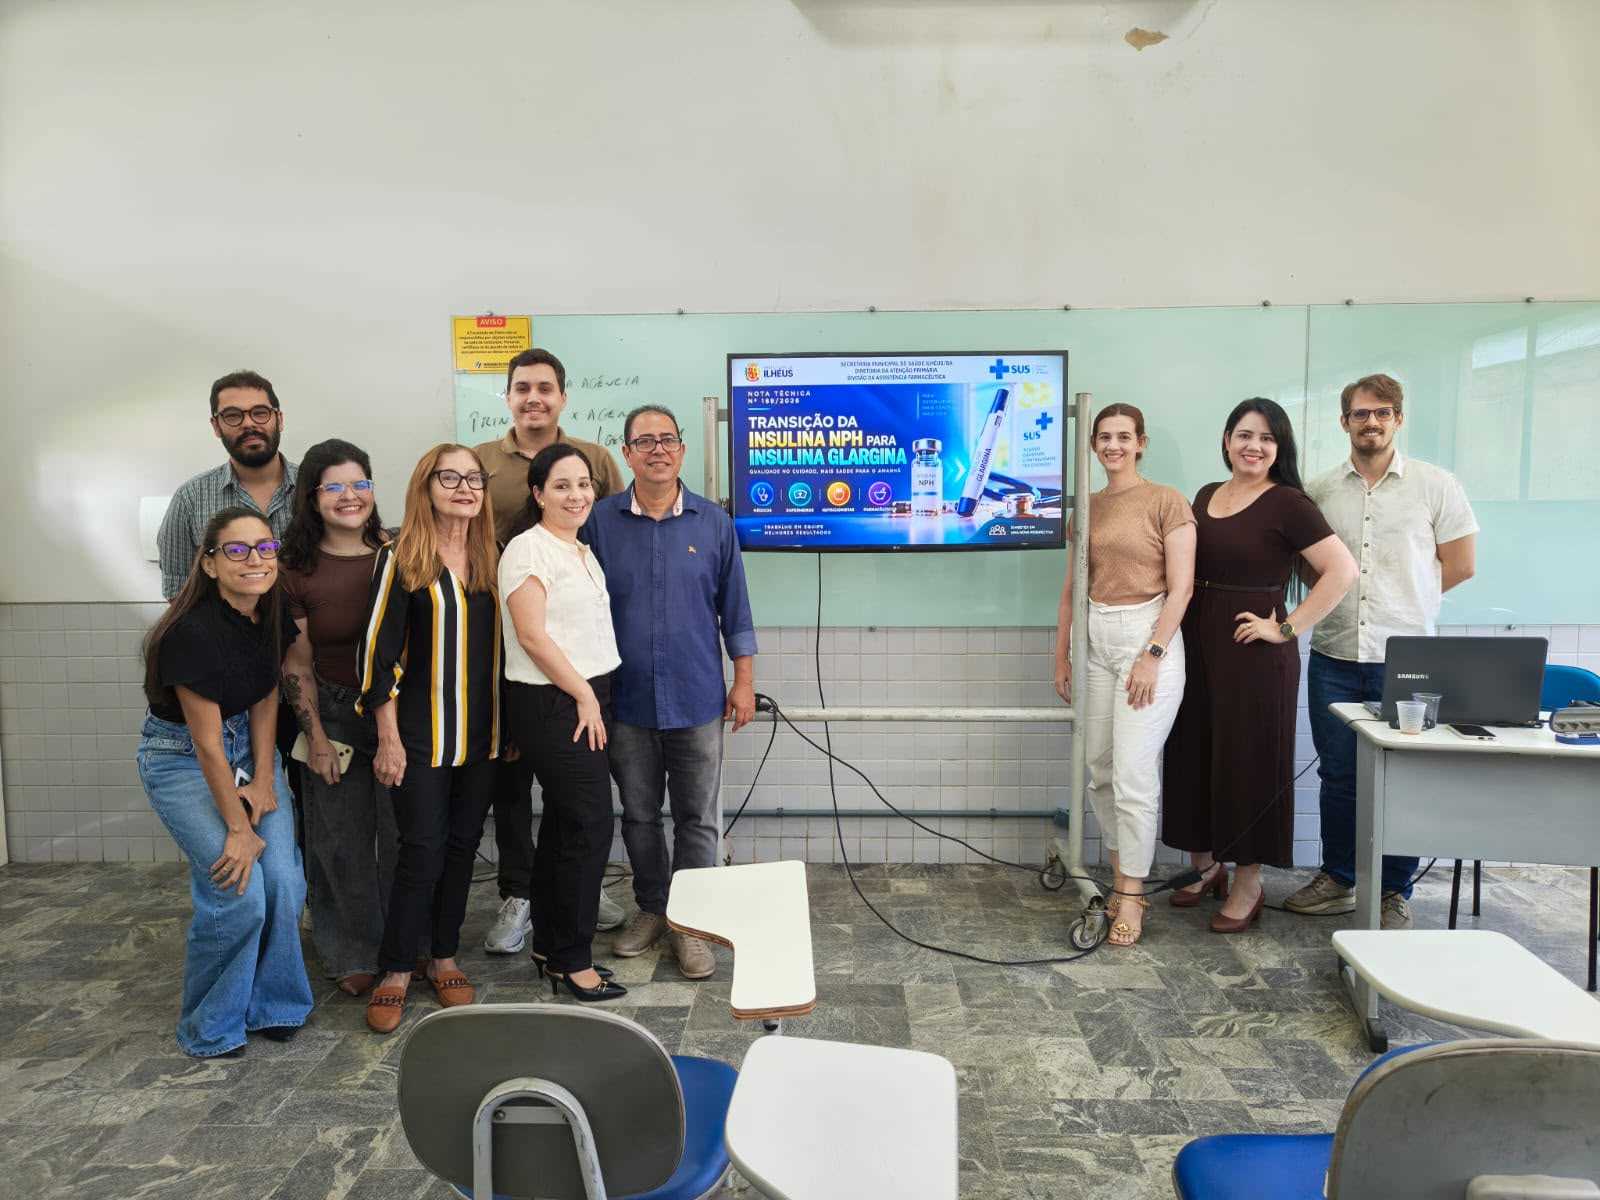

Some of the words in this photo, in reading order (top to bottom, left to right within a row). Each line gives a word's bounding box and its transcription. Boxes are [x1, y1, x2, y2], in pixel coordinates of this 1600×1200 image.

[763, 367, 794, 378] ILHÉUS
[1010, 364, 1031, 374] SUS
[587, 409, 626, 421] AGEN
[748, 413, 835, 431] TRANSIÇÃO
[837, 416, 858, 428] DA
[748, 431, 826, 448] INSULINA
[829, 430, 863, 447] NPH
[866, 435, 897, 446] PARA
[1023, 431, 1041, 441] SUS
[749, 448, 825, 466] INSULINA
[828, 447, 908, 465] GLARGINA
[976, 447, 992, 482] GLARGINA
[918, 479, 935, 487] NPH
